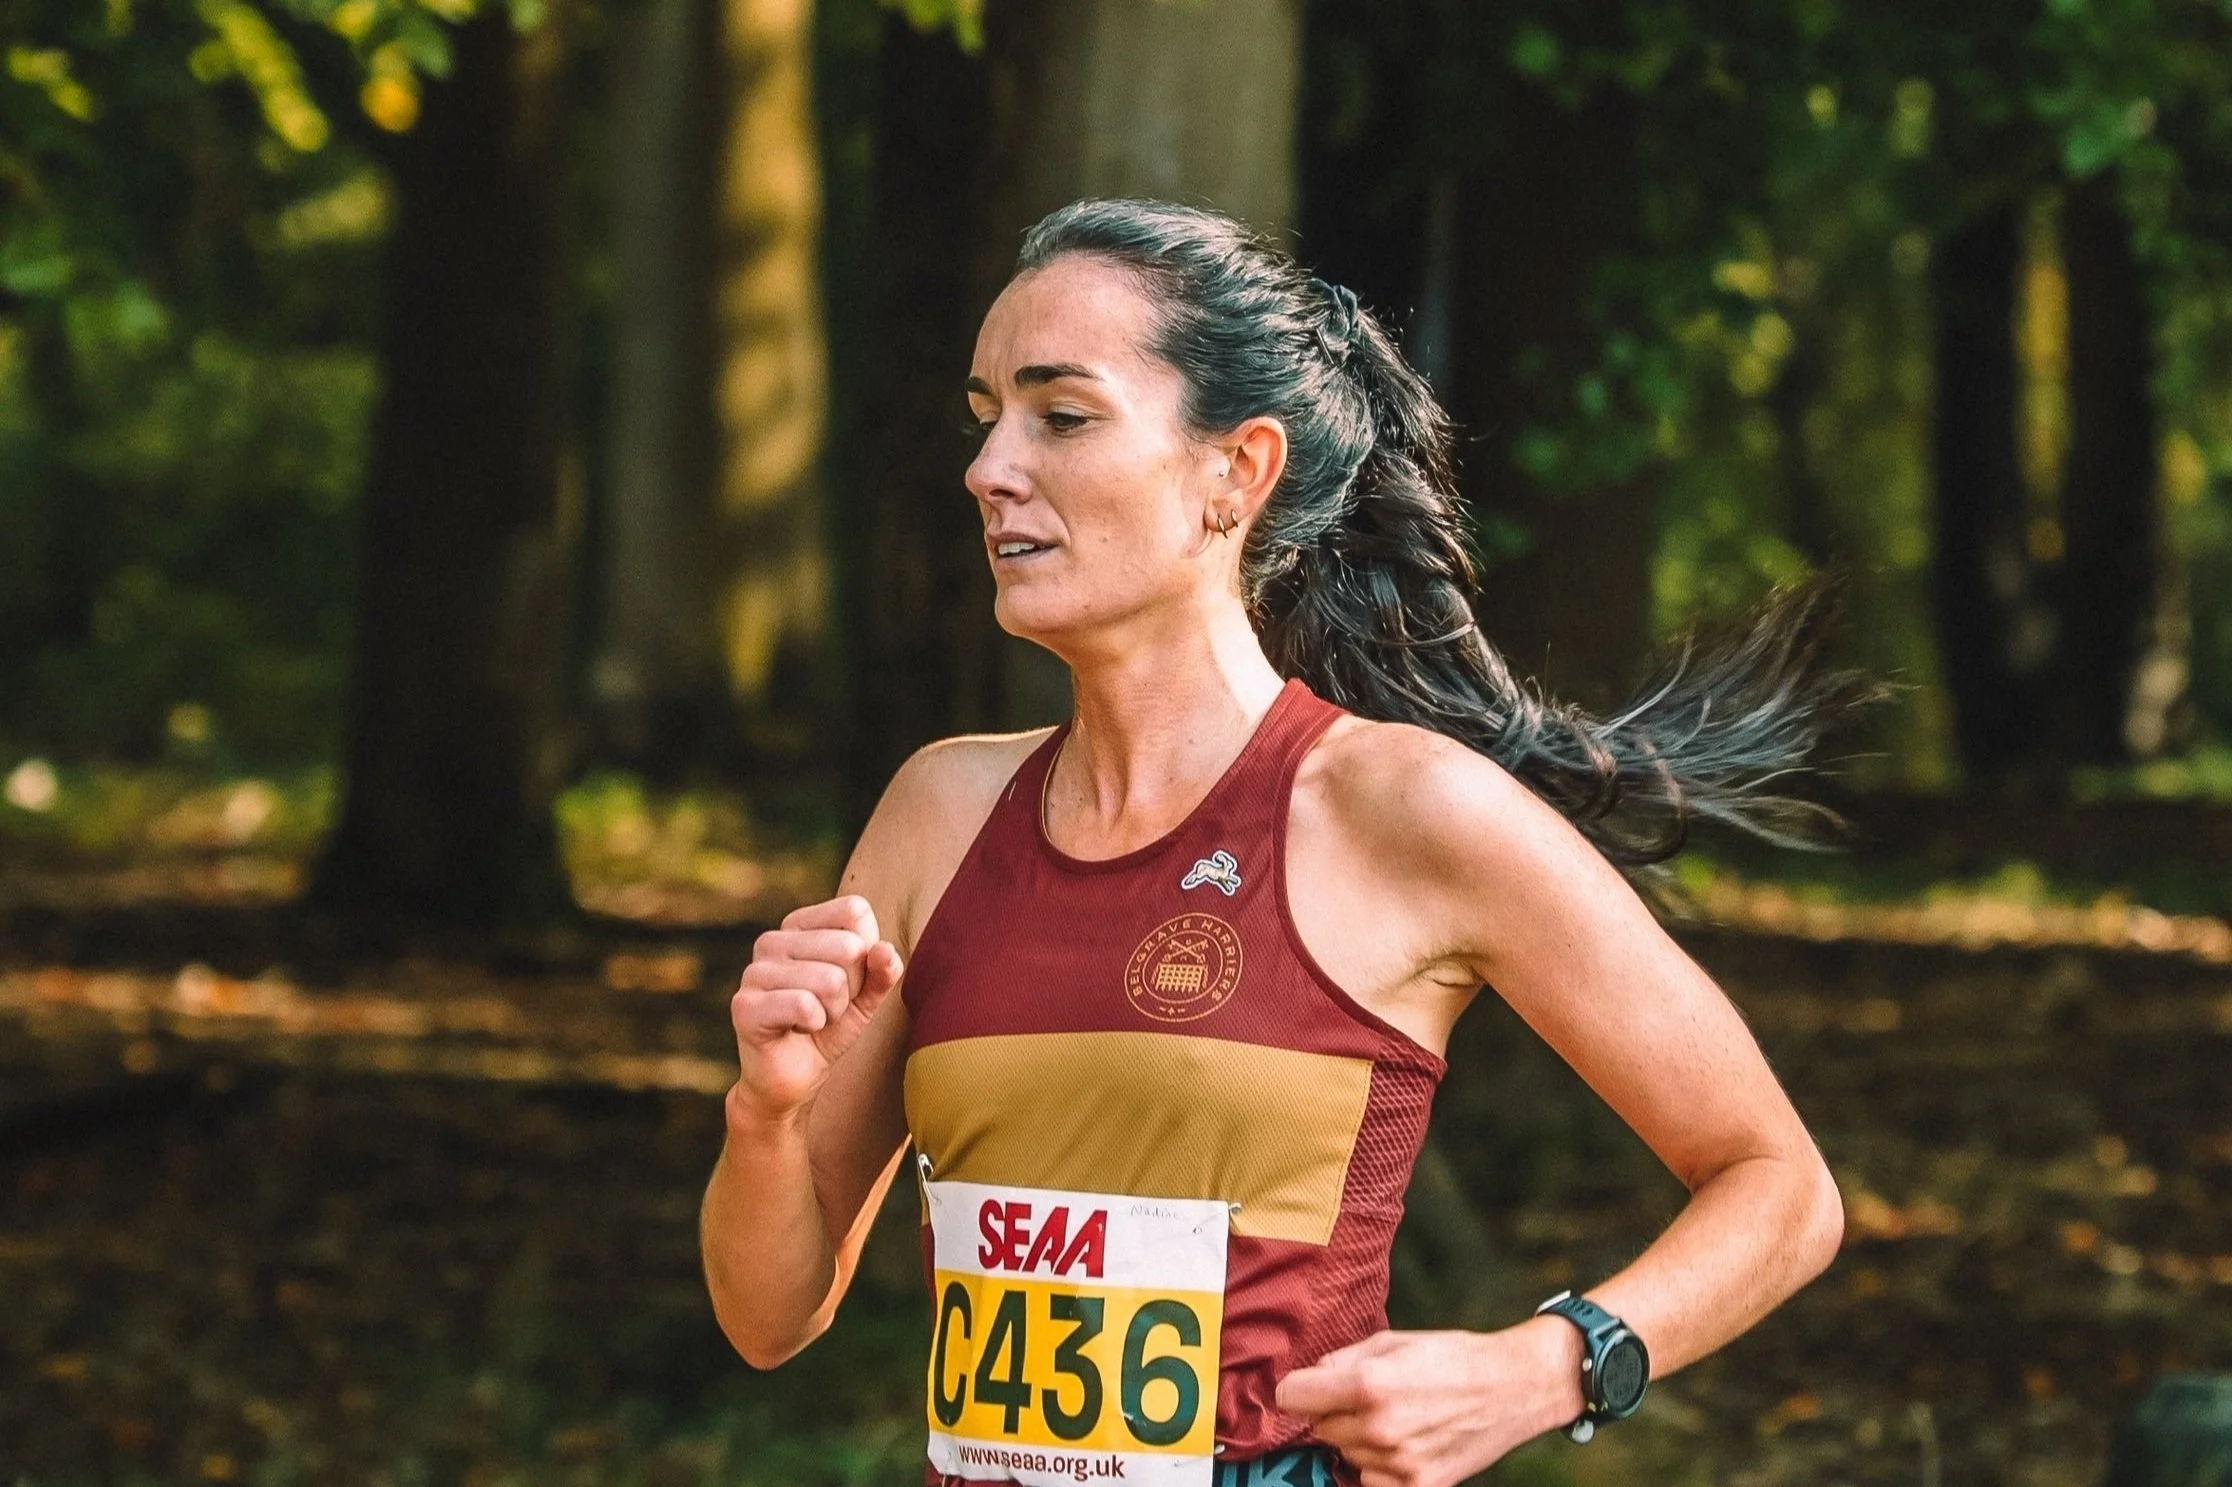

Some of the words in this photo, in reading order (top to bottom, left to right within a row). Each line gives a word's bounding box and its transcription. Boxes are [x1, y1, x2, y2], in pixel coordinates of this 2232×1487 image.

[1130, 919, 1192, 996] BELGRAVE
[1201, 920, 1237, 1000] HARRIERS
[978, 1199, 1108, 1278] SEAA
[933, 1281, 1202, 1447] C436
[958, 1445, 1126, 1480] www.seaa.org.uk
